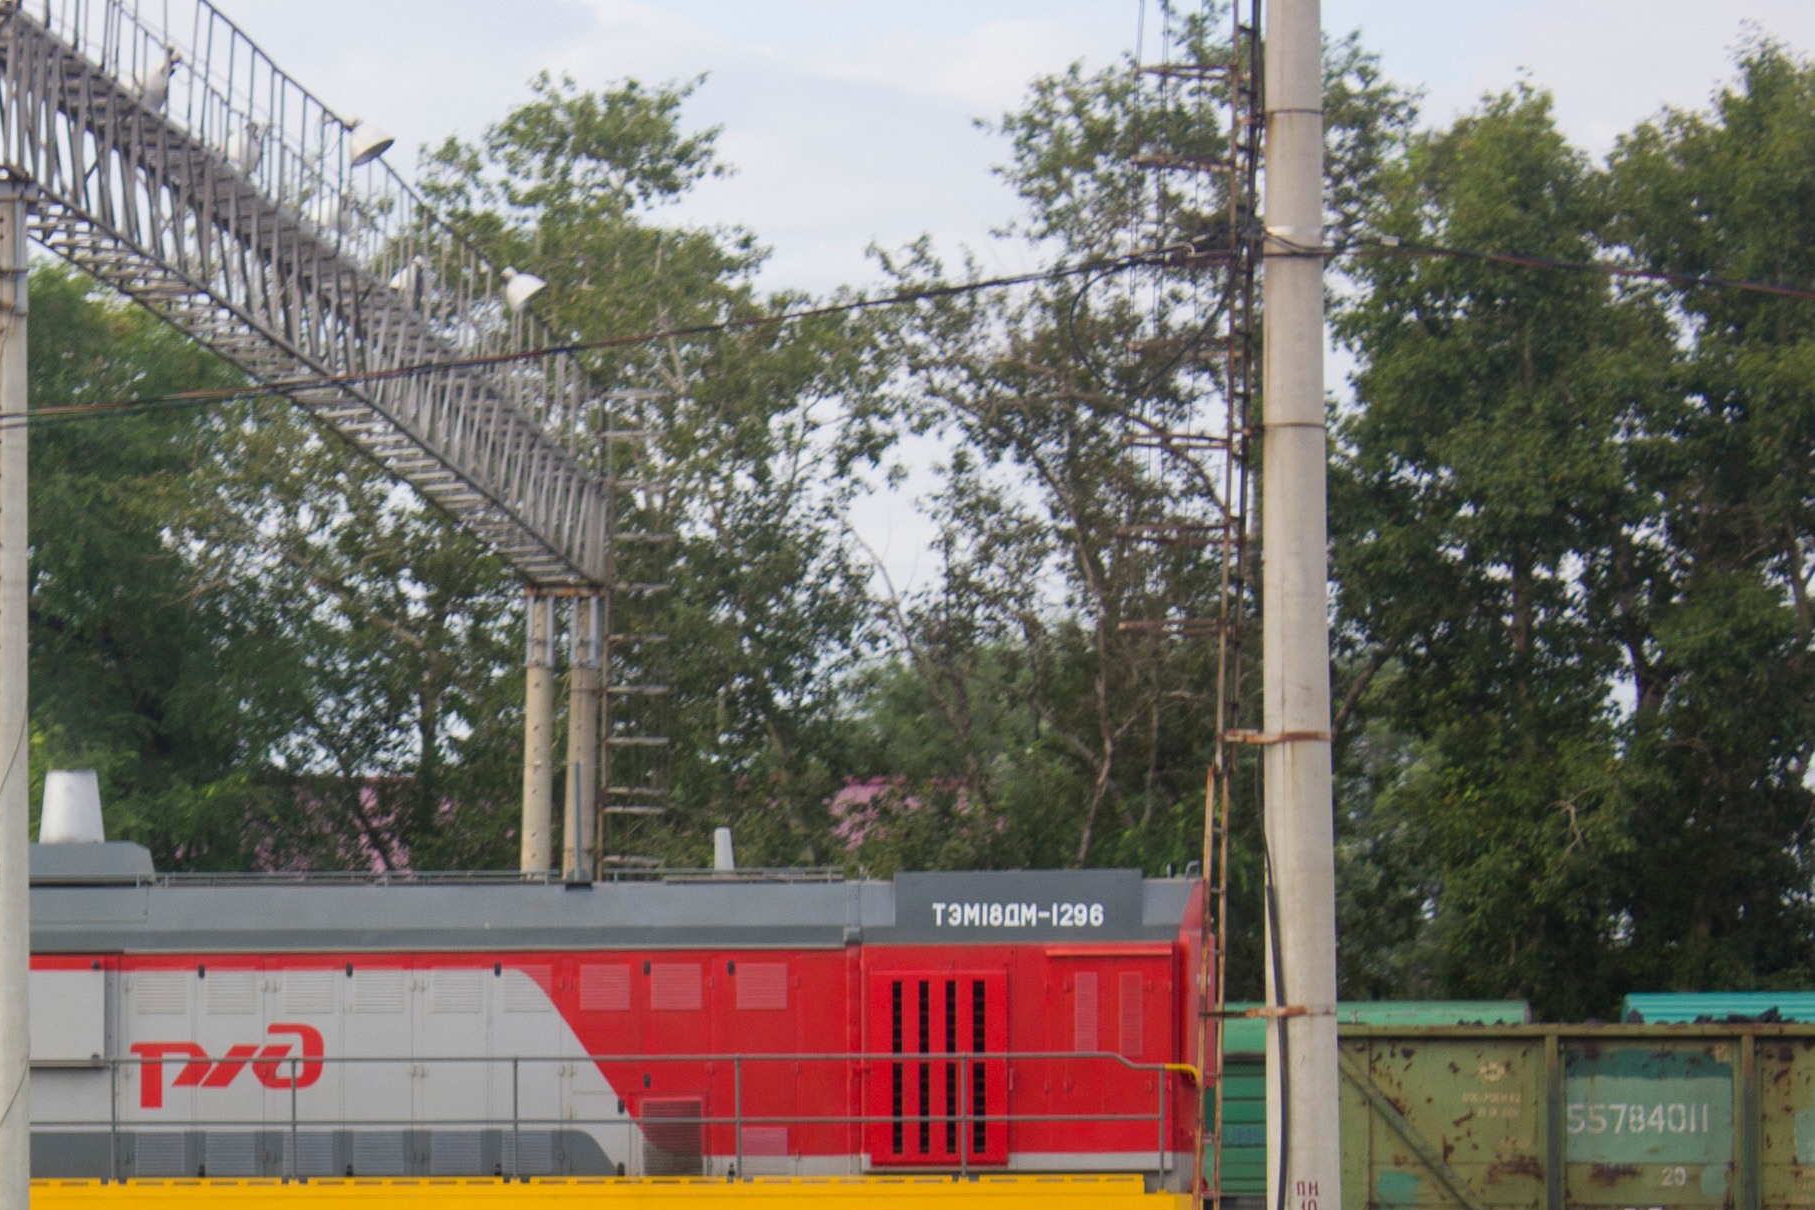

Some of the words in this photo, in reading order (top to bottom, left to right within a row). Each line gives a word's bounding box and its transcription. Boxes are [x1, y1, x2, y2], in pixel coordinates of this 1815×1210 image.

[931, 902, 1105, 928] ТЭМ18ДМ-1296
[130, 1022, 325, 1110] РЖД
[1566, 1103, 1708, 1134] 55784011
[1661, 1166, 1687, 1187] 20
